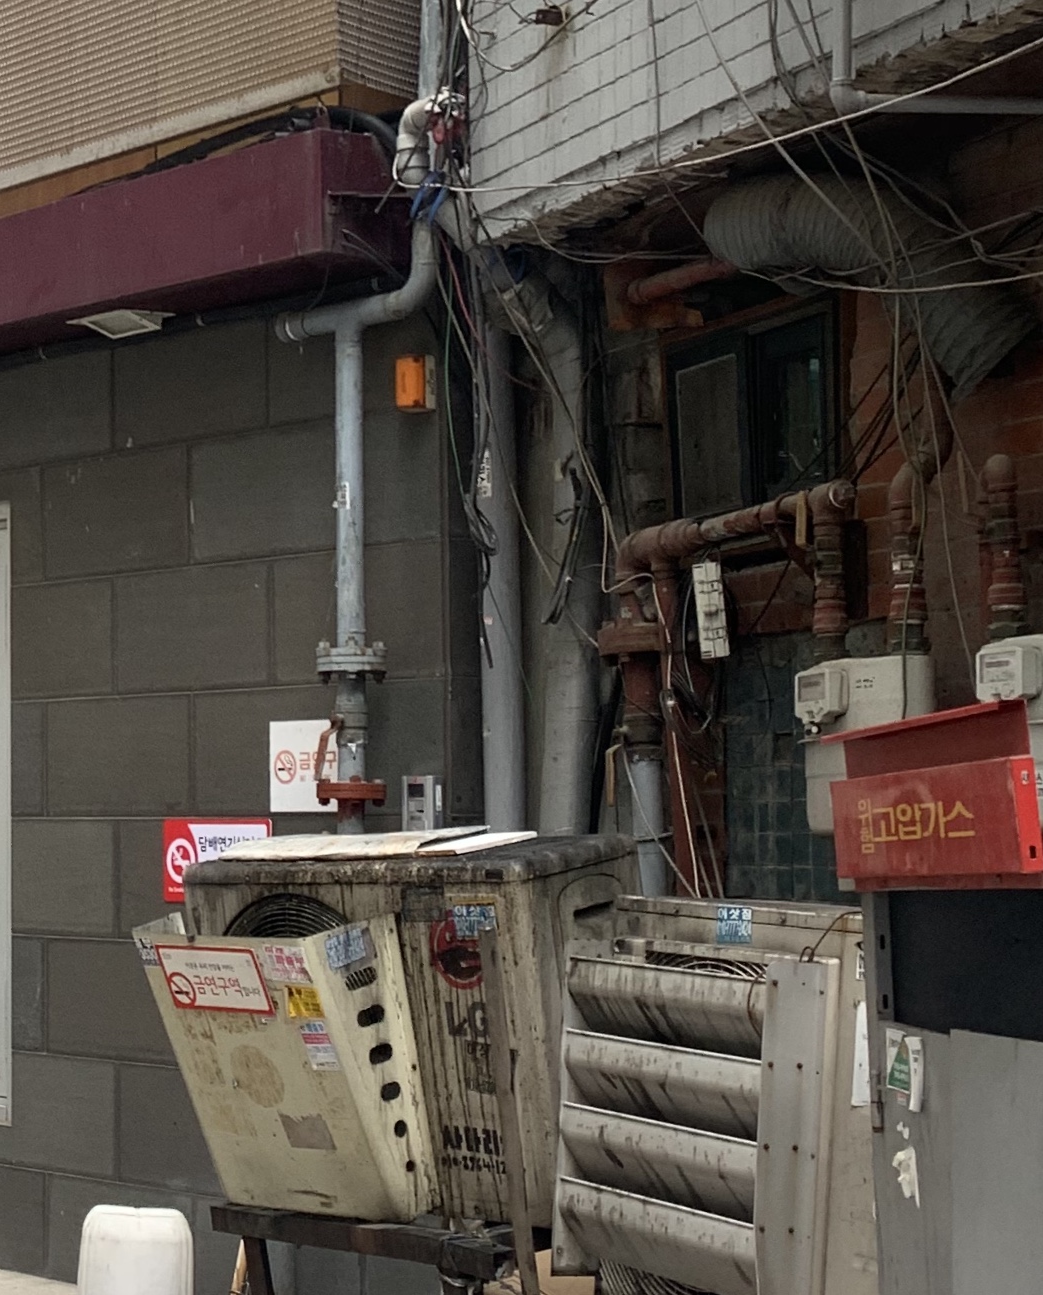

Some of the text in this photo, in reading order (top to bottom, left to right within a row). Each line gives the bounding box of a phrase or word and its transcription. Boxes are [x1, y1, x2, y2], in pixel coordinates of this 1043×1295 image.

[872, 800, 976, 843] 고압가스
[718, 907, 752, 921] 이삿짐
[193, 975, 244, 998] 금연구역
